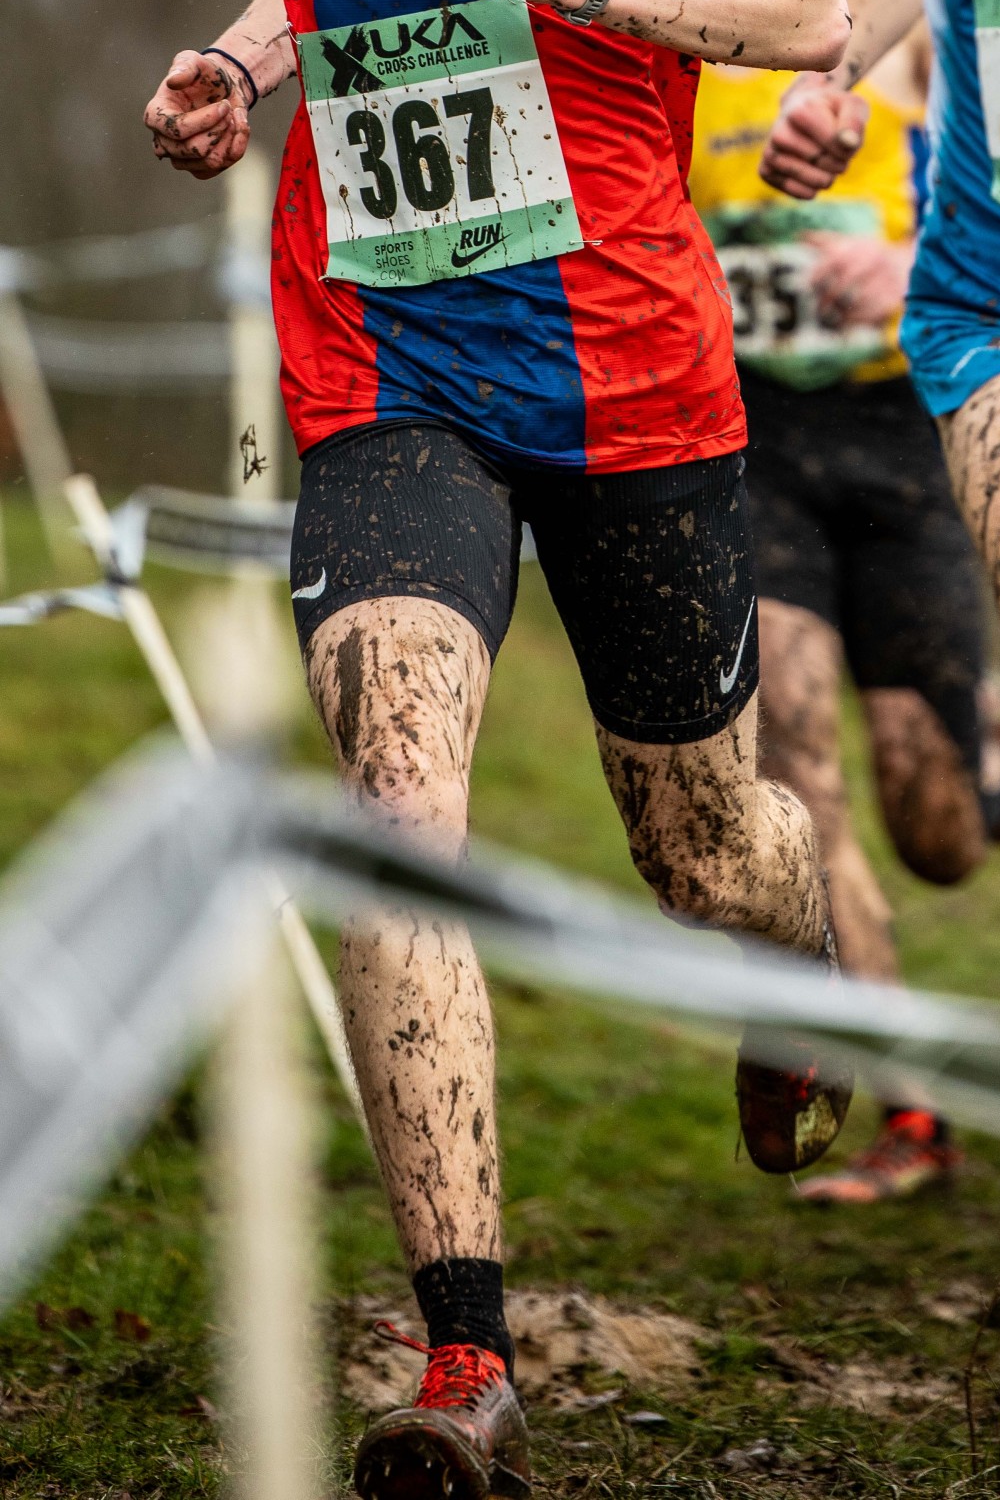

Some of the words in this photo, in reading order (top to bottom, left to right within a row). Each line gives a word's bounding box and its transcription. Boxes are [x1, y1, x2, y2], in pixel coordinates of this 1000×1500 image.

[376, 55, 417, 76] CROSS
[418, 41, 490, 68] CHALLENGE
[346, 86, 498, 220] 367
[374, 240, 415, 256] SPORTS
[460, 221, 502, 250] RUN
[375, 254, 411, 269] SHOES
